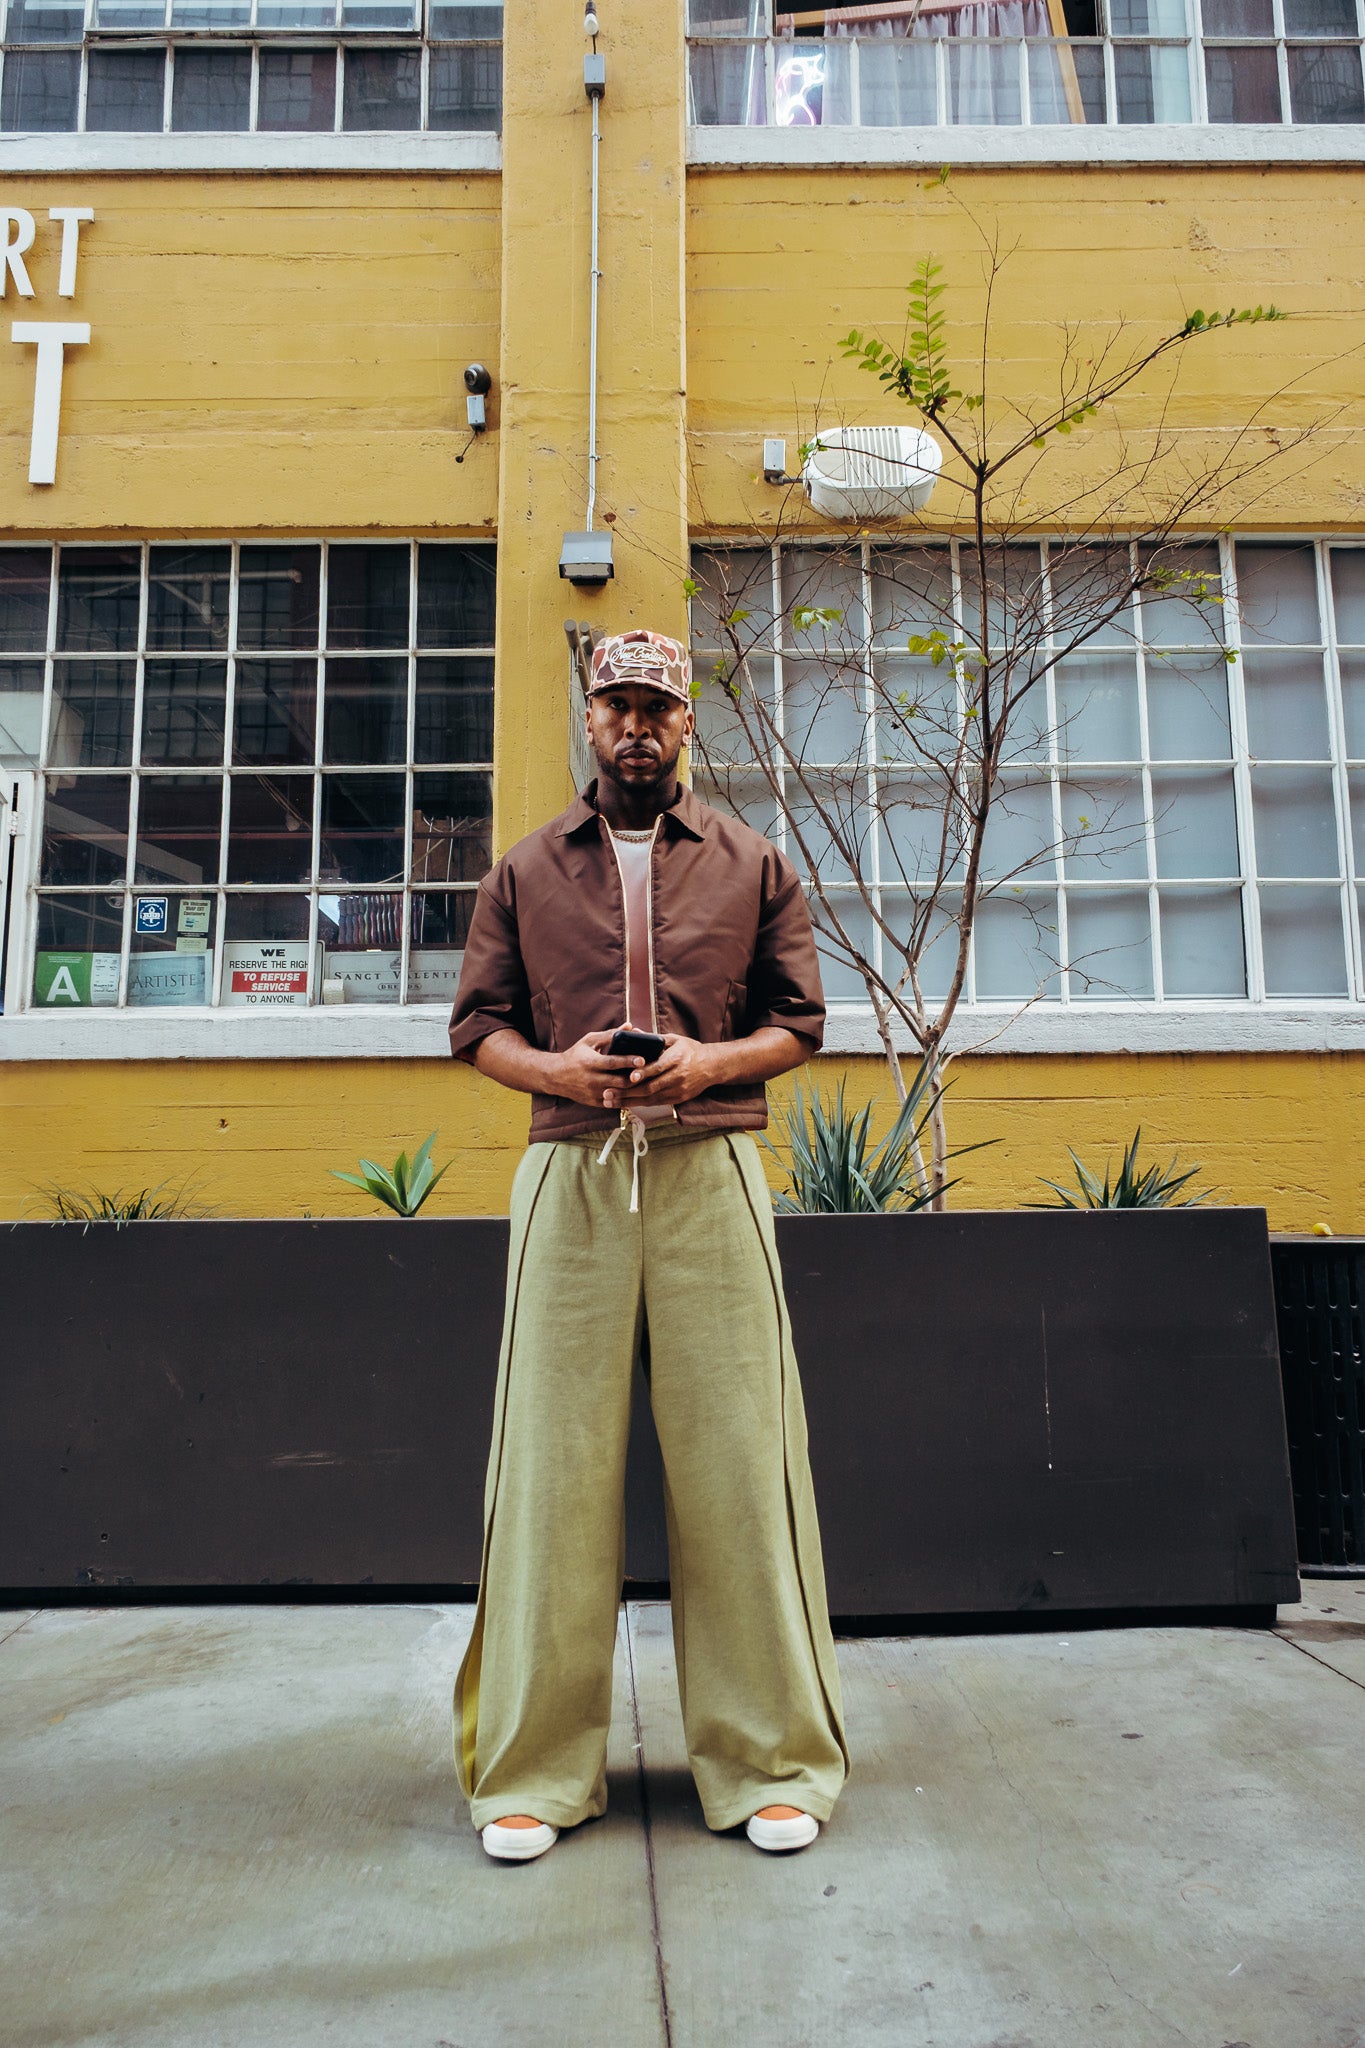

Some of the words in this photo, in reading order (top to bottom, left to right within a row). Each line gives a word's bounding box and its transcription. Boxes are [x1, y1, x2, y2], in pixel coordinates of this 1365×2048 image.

[11, 321, 91, 484] T
[260, 949, 286, 957] WE
[229, 960, 267, 969] RESERVE
[271, 960, 287, 969] THE
[290, 960, 309, 969] RIGH
[132, 974, 196, 989] ARTISTE
[243, 973, 257, 982] TO
[260, 973, 301, 982] REFUSE
[46, 965, 81, 1002] A
[251, 983, 291, 992] SERVICE
[246, 995, 257, 1004] TO
[260, 995, 295, 1004] ANYONE
